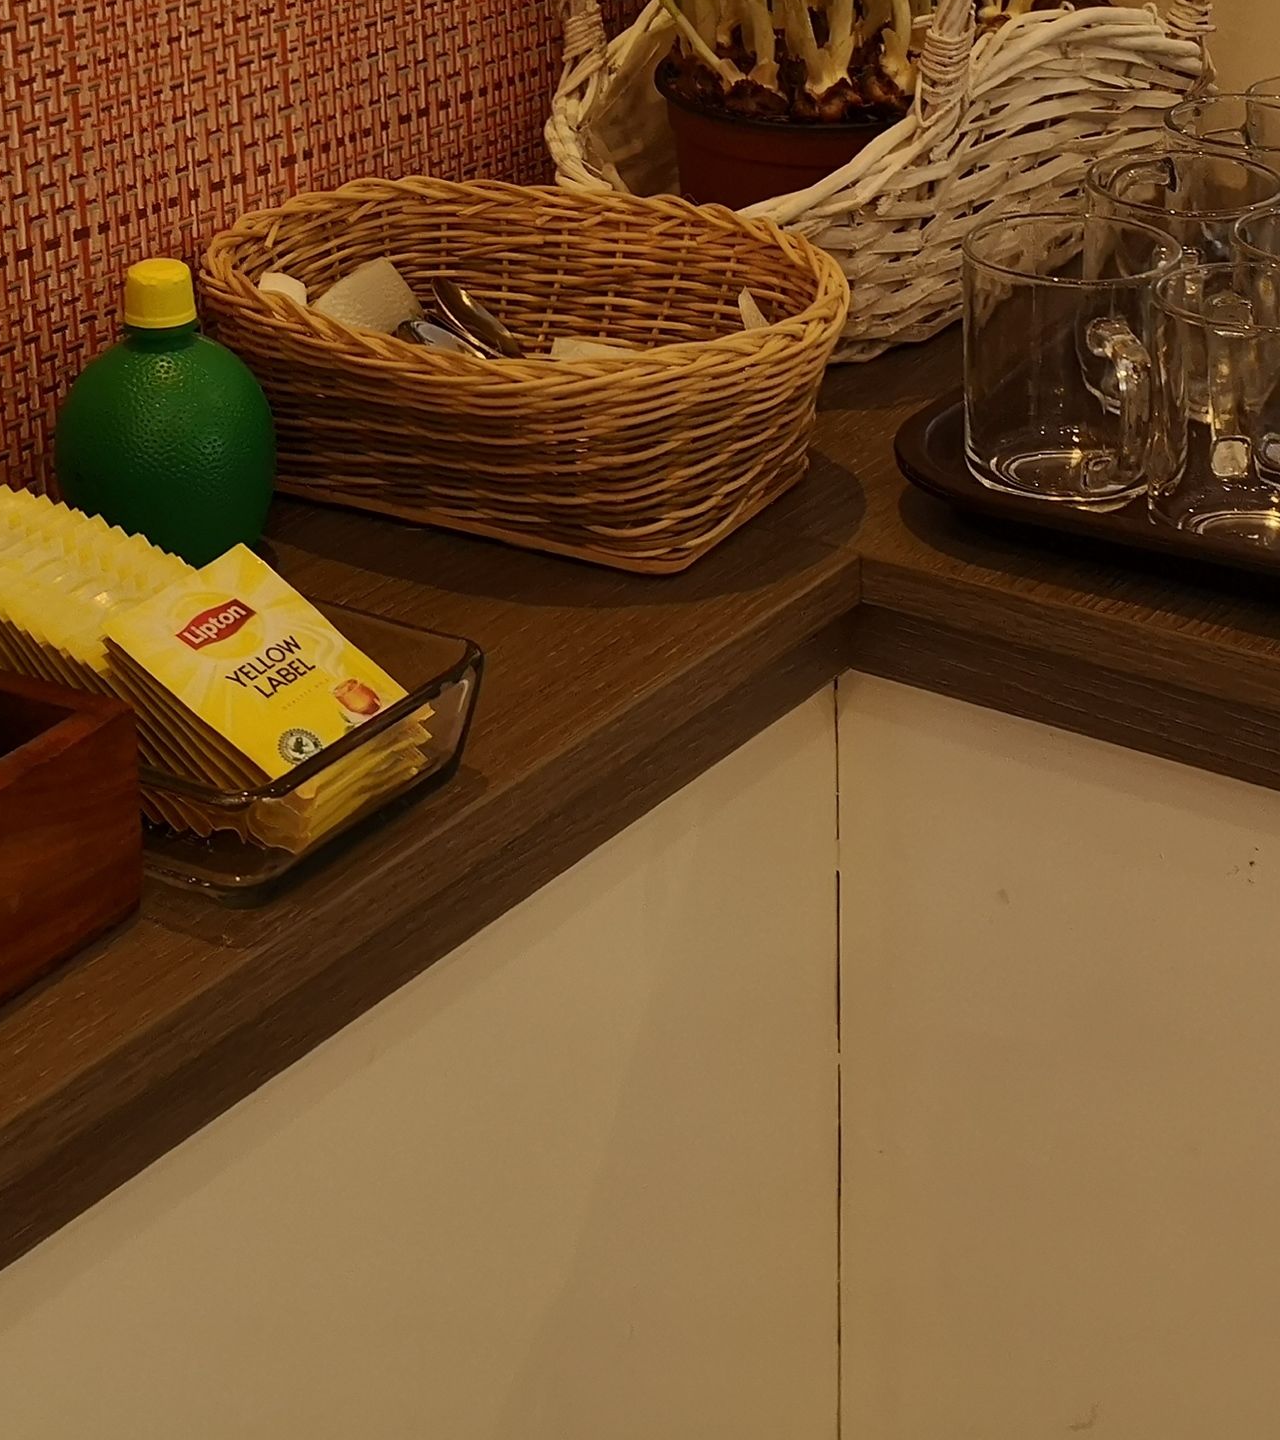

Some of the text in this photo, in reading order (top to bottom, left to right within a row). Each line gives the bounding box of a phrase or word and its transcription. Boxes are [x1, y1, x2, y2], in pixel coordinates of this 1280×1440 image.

[182, 604, 248, 645] Lipton
[225, 634, 302, 688] YELLOW
[254, 657, 316, 699] LABEL
